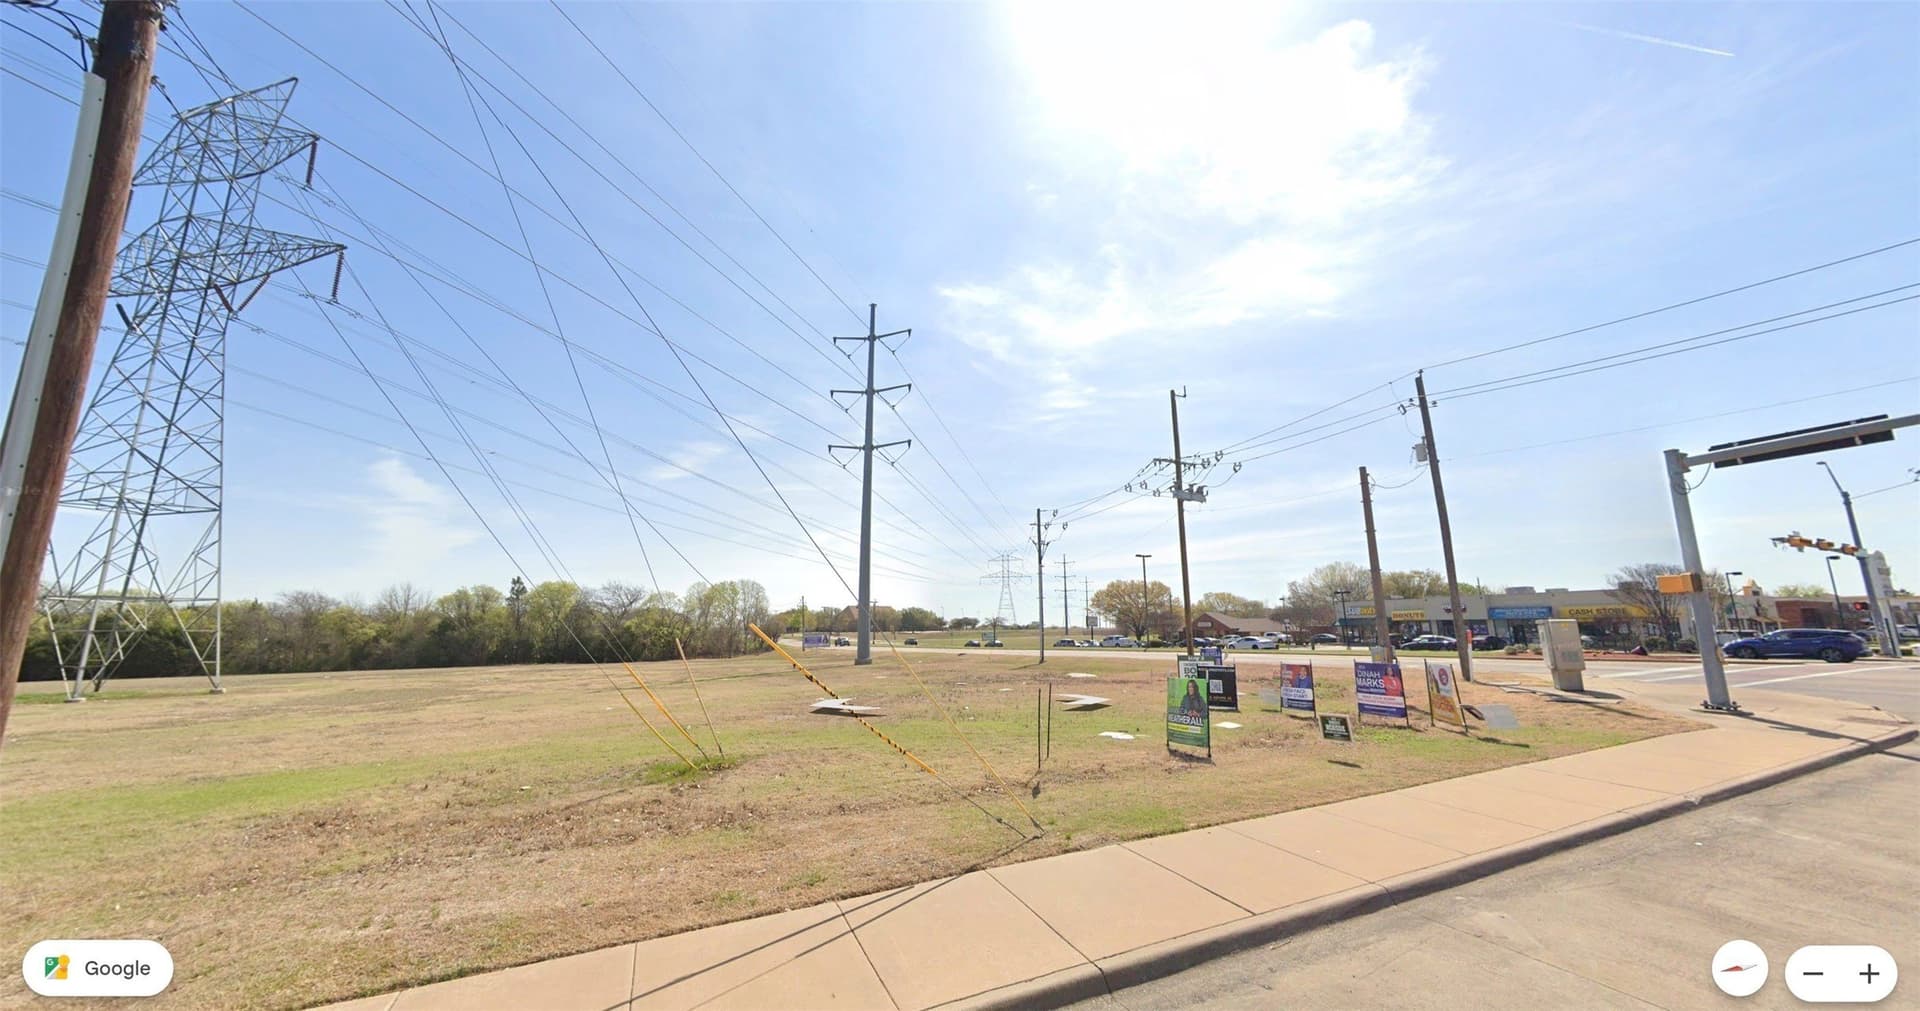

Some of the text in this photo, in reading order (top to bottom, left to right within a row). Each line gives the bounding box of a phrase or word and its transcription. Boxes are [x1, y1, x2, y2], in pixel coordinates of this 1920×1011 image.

[1568, 607, 1626, 616] CASH STORE
[1358, 670, 1380, 678] DINAH
[1356, 678, 1385, 688] MARKS
